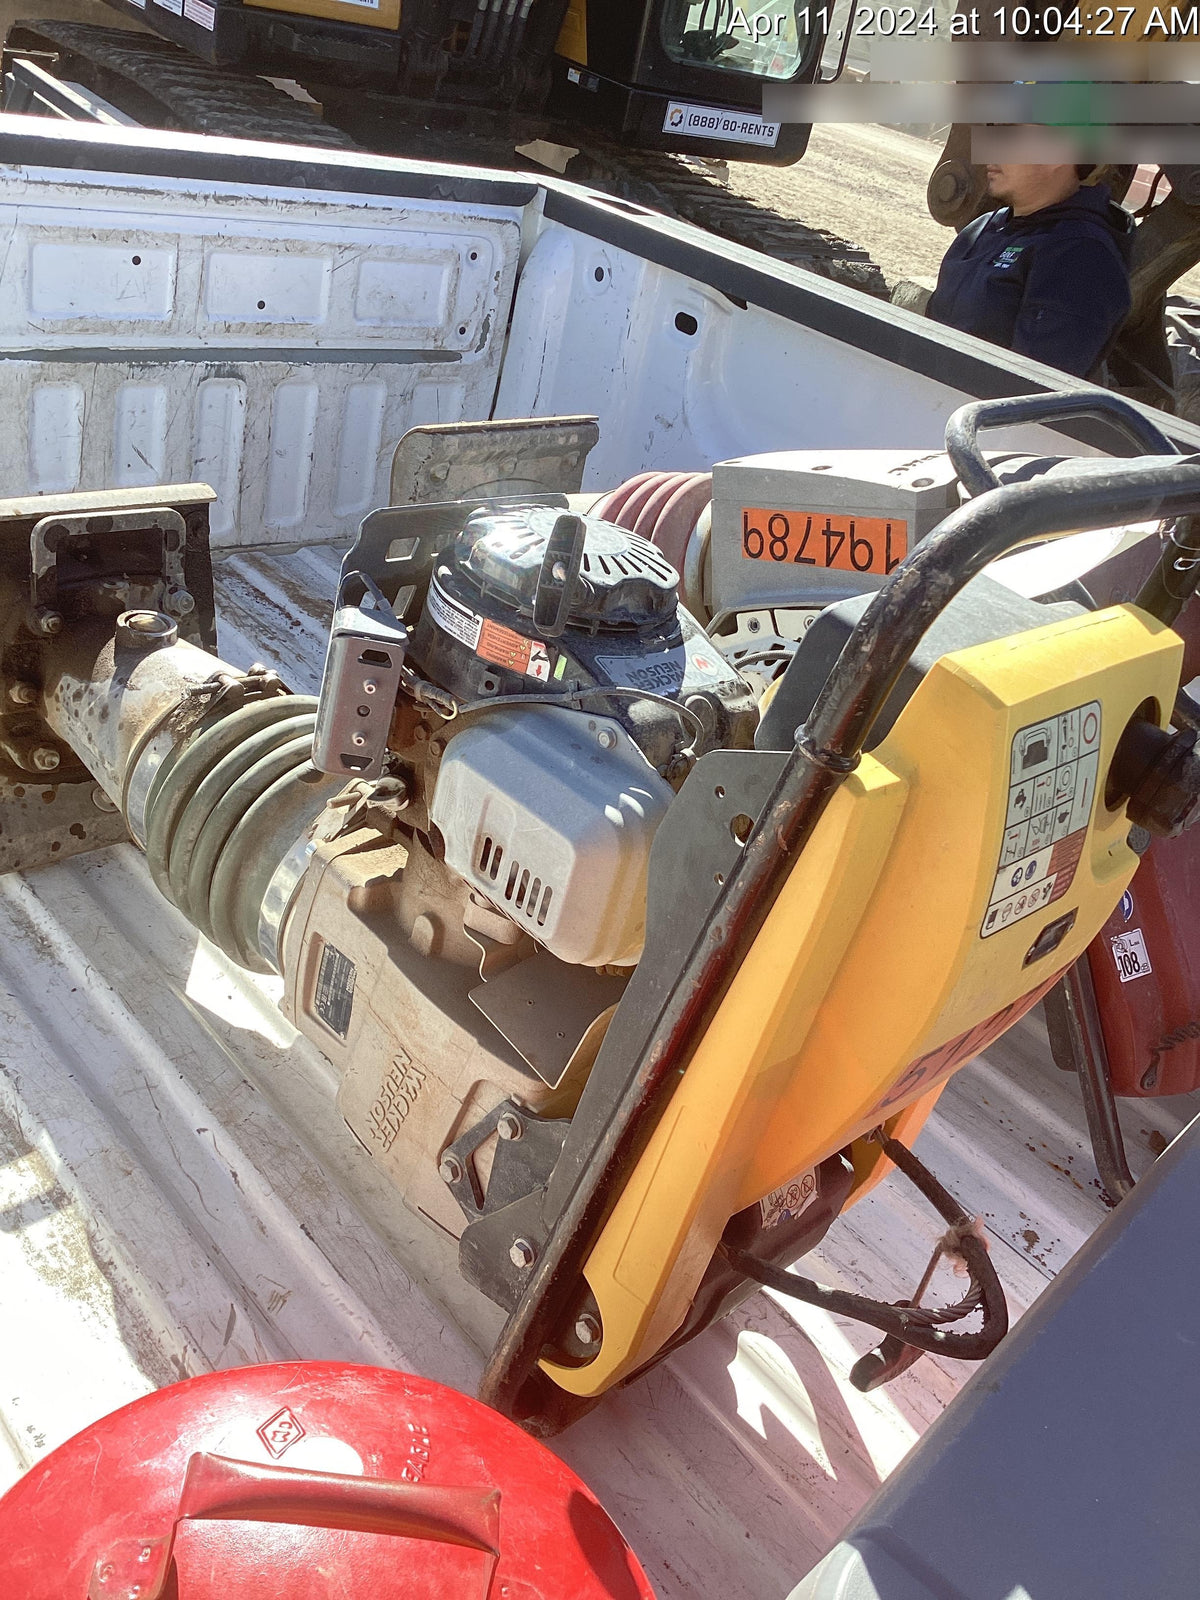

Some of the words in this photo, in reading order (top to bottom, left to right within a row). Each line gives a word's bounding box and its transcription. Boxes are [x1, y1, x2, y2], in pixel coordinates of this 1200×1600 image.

[722, 119, 775, 137] 80-RENTS
[743, 511, 900, 575] 194789
[624, 660, 683, 683] NEUSON
[1118, 951, 1141, 976] 108
[364, 1045, 413, 1140] NEUSON
[382, 1065, 427, 1154] WACKER
